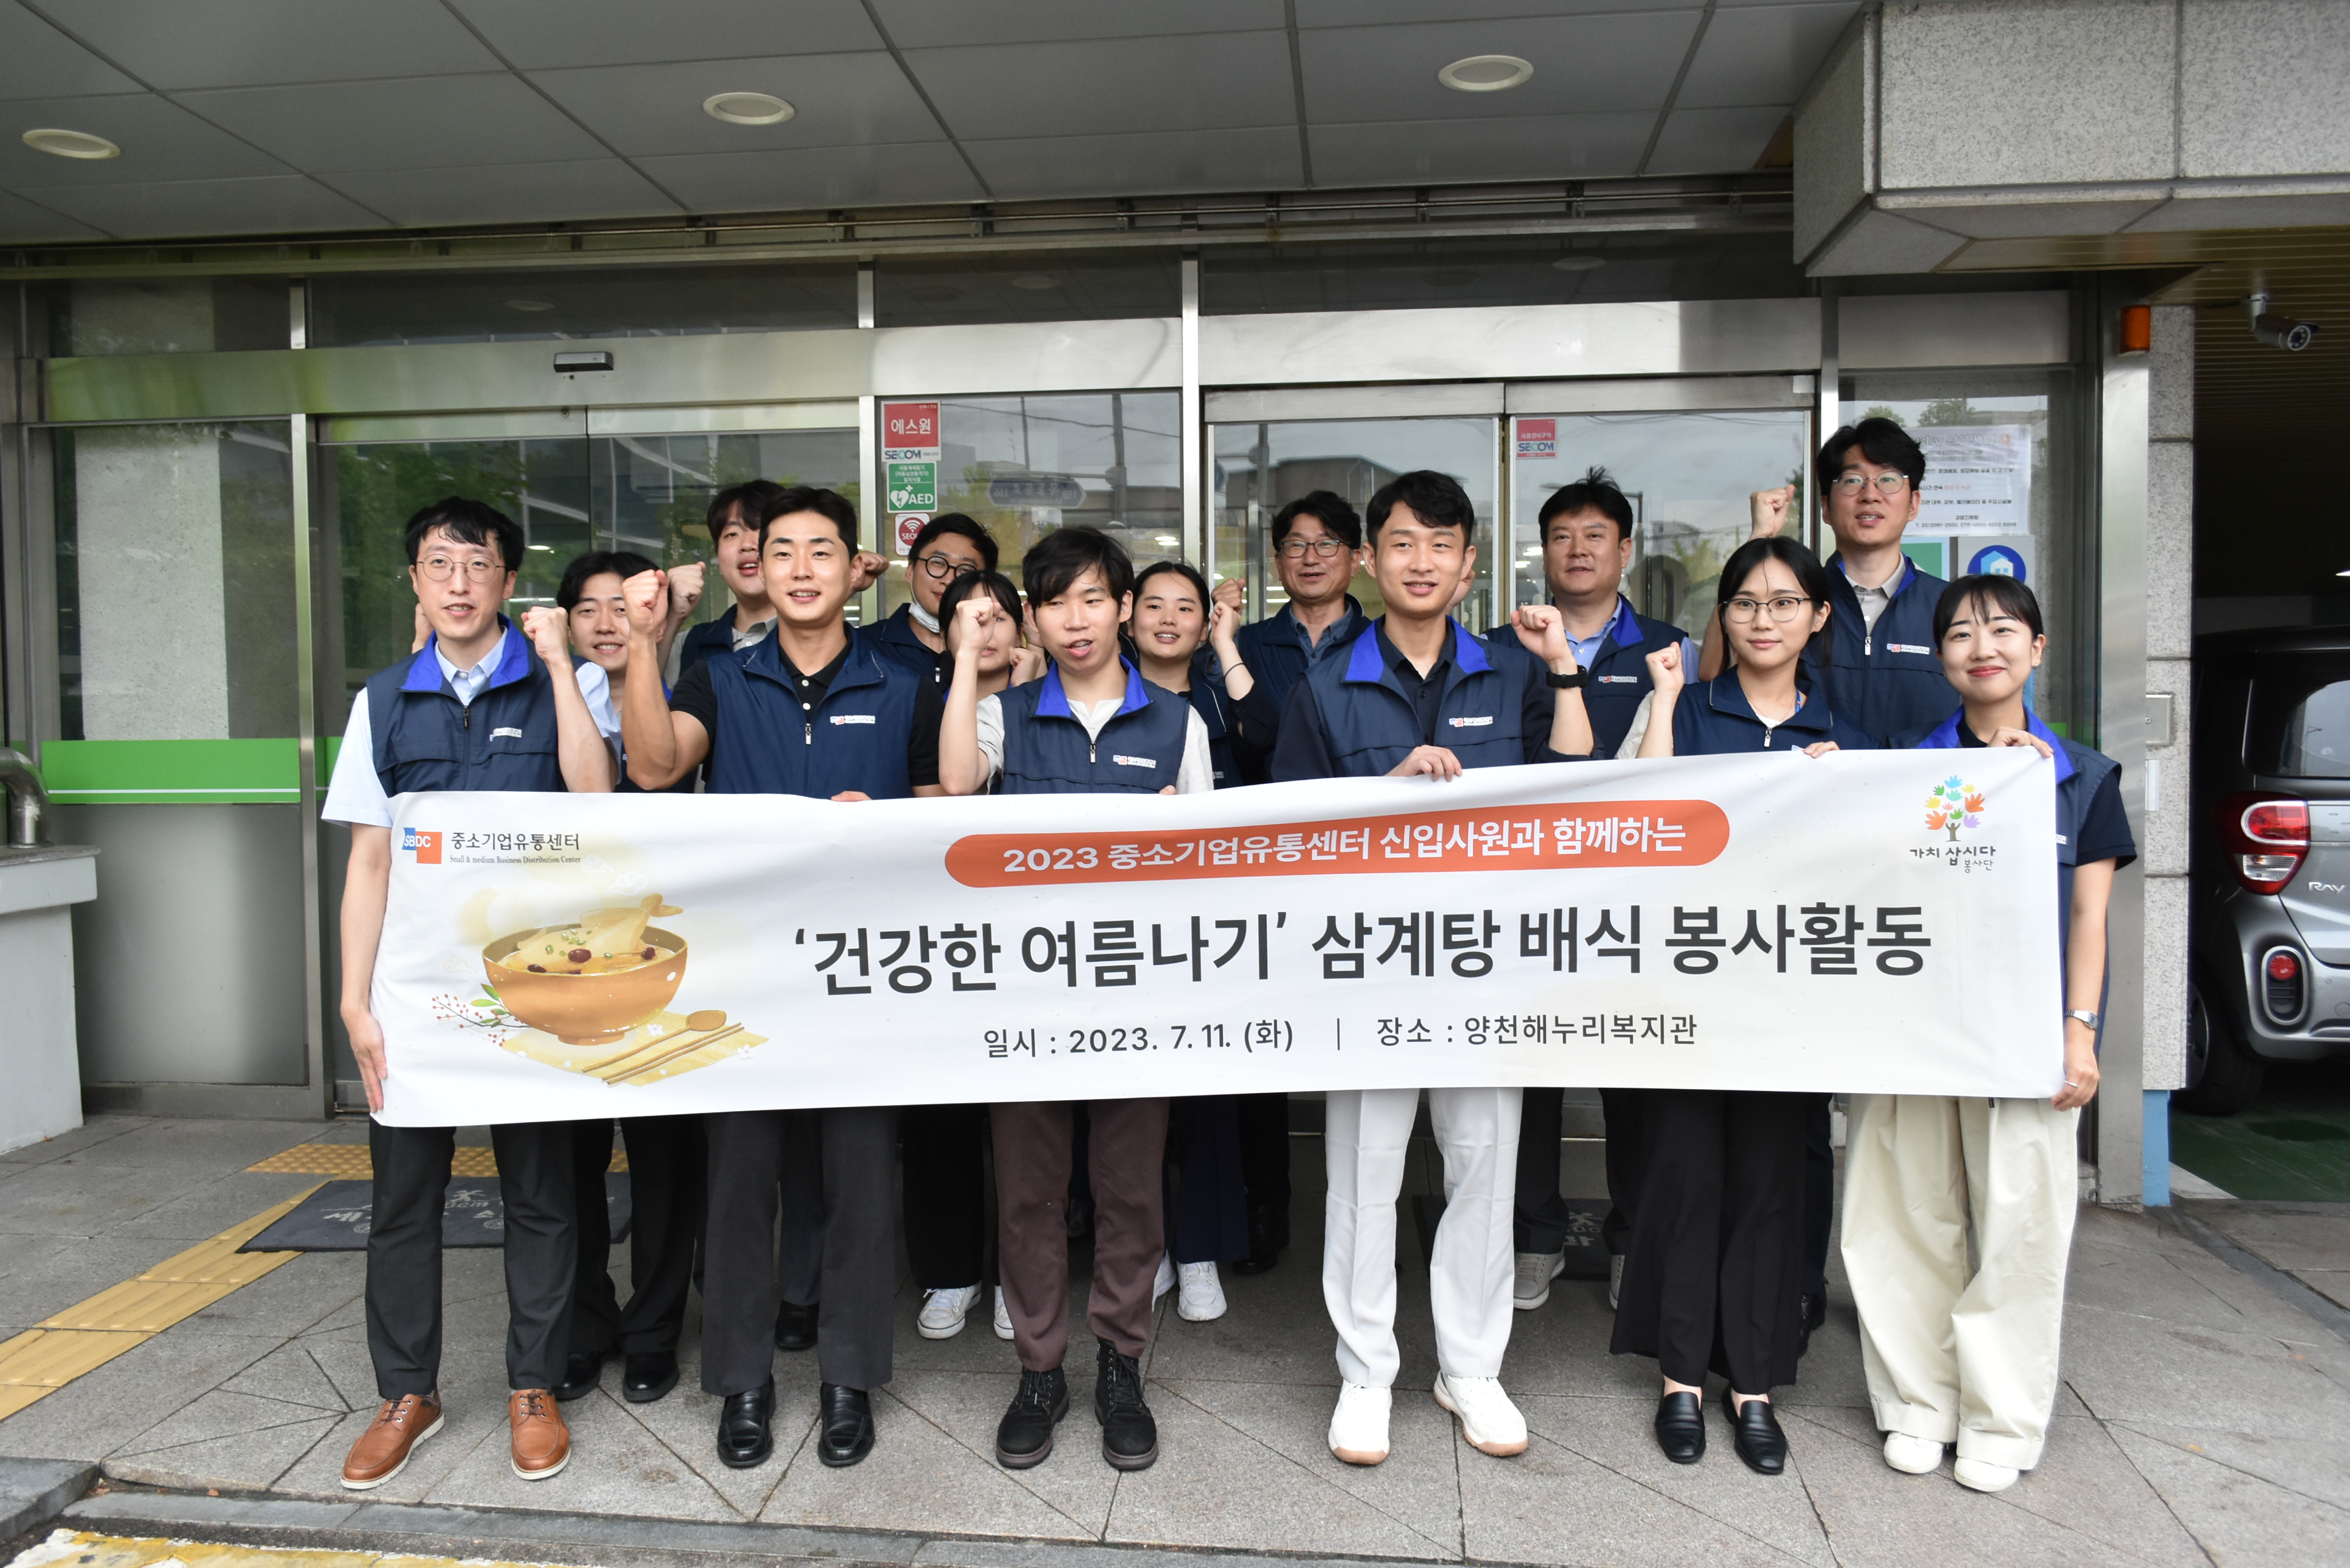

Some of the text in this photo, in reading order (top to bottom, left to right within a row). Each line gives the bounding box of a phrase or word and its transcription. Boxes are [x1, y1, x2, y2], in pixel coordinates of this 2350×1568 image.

[891, 418, 930, 434] 에스원
[885, 450, 921, 459] SECOM
[1519, 442, 1554, 452] SECOM
[908, 493, 934, 504] AED
[404, 835, 431, 848] SBDC
[451, 833, 579, 851] 중소기업유통센터
[1004, 816, 1686, 872] 2023 중소기업유통센터 신입사원과 함께하는
[1909, 846, 1996, 866] 가치 삽시다
[1964, 859, 1994, 873] 봉사단
[796, 902, 1931, 996] ‘건강한 여름나기’ 삼계탕 배식 봉사활동
[984, 1029, 1035, 1058] 일시
[1051, 1036, 1056, 1054] :
[1069, 1028, 1157, 1053] 2023.
[1244, 1019, 1293, 1053] (화)
[1377, 1014, 1697, 1046] 장소 : 양천해누리복지관
